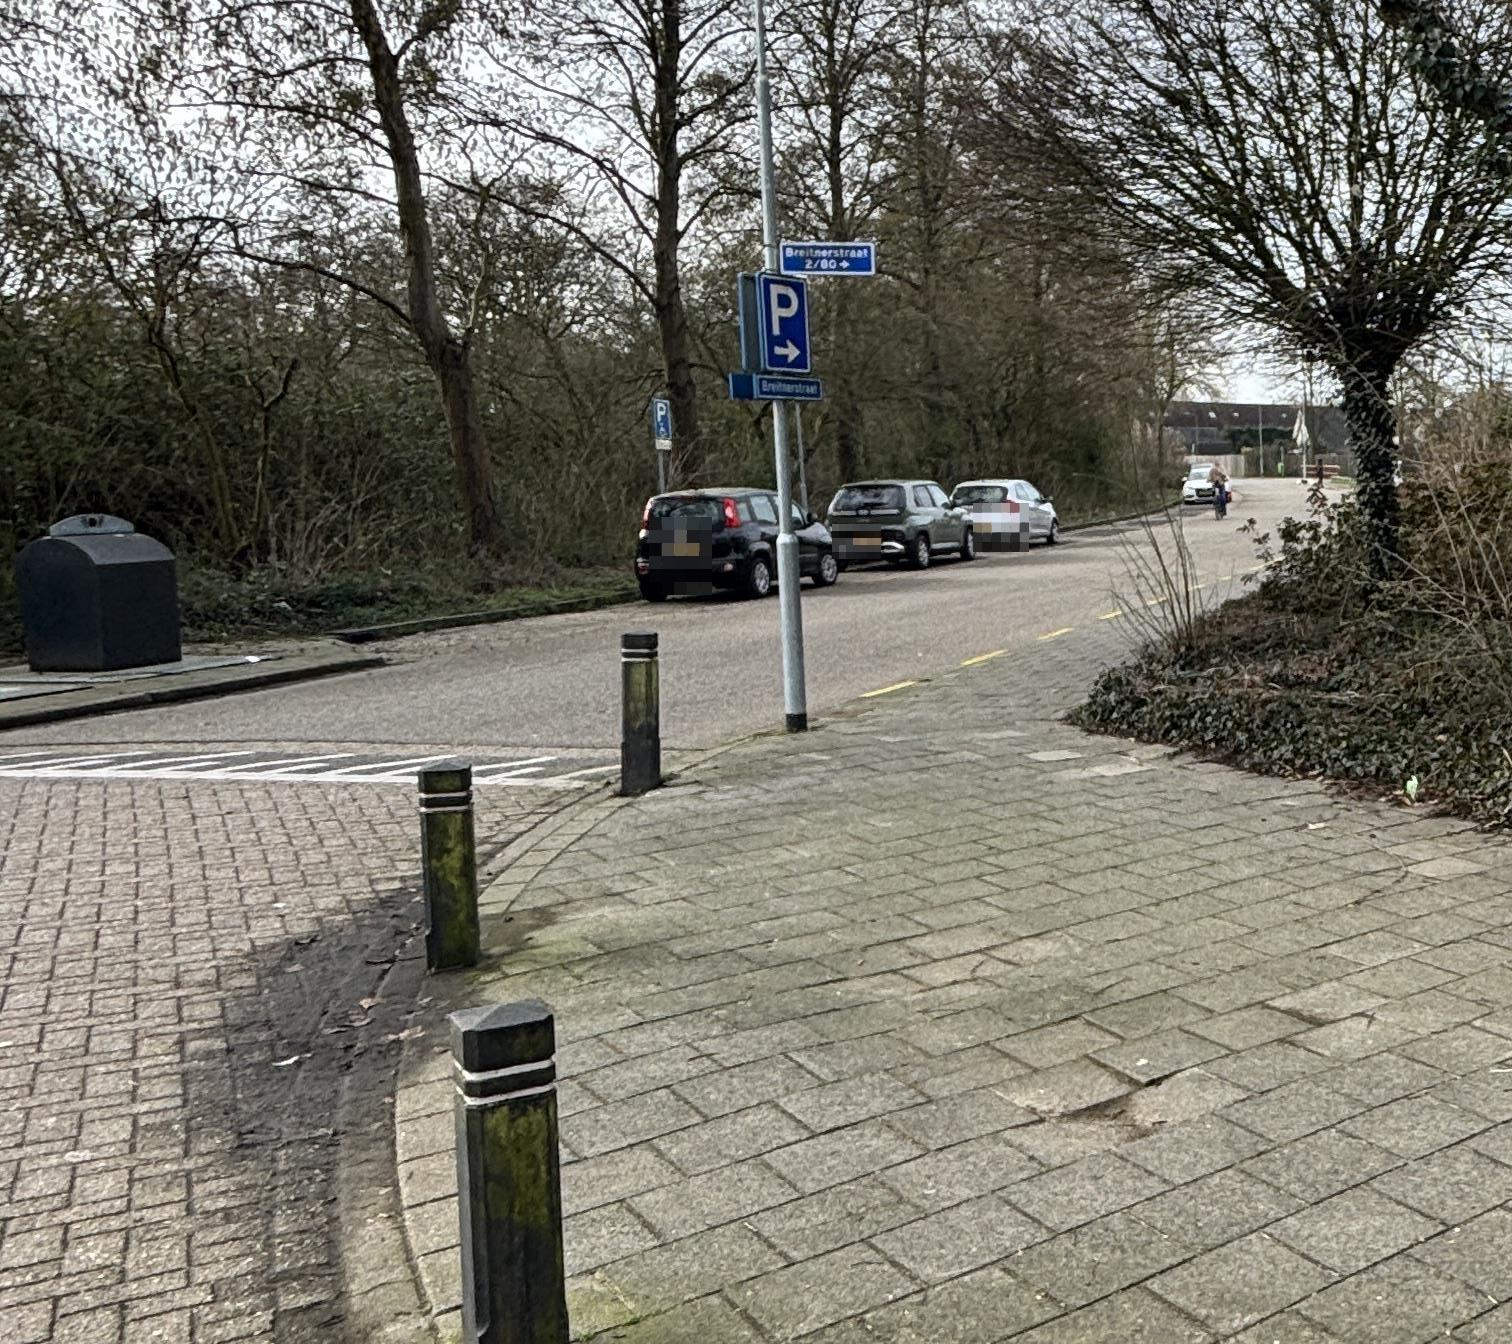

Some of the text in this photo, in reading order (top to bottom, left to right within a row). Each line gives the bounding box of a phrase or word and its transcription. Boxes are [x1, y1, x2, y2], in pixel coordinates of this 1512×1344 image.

[785, 247, 868, 258] Breitnerstraat
[769, 283, 799, 336] P
[761, 380, 818, 395] Breitnerstraat
